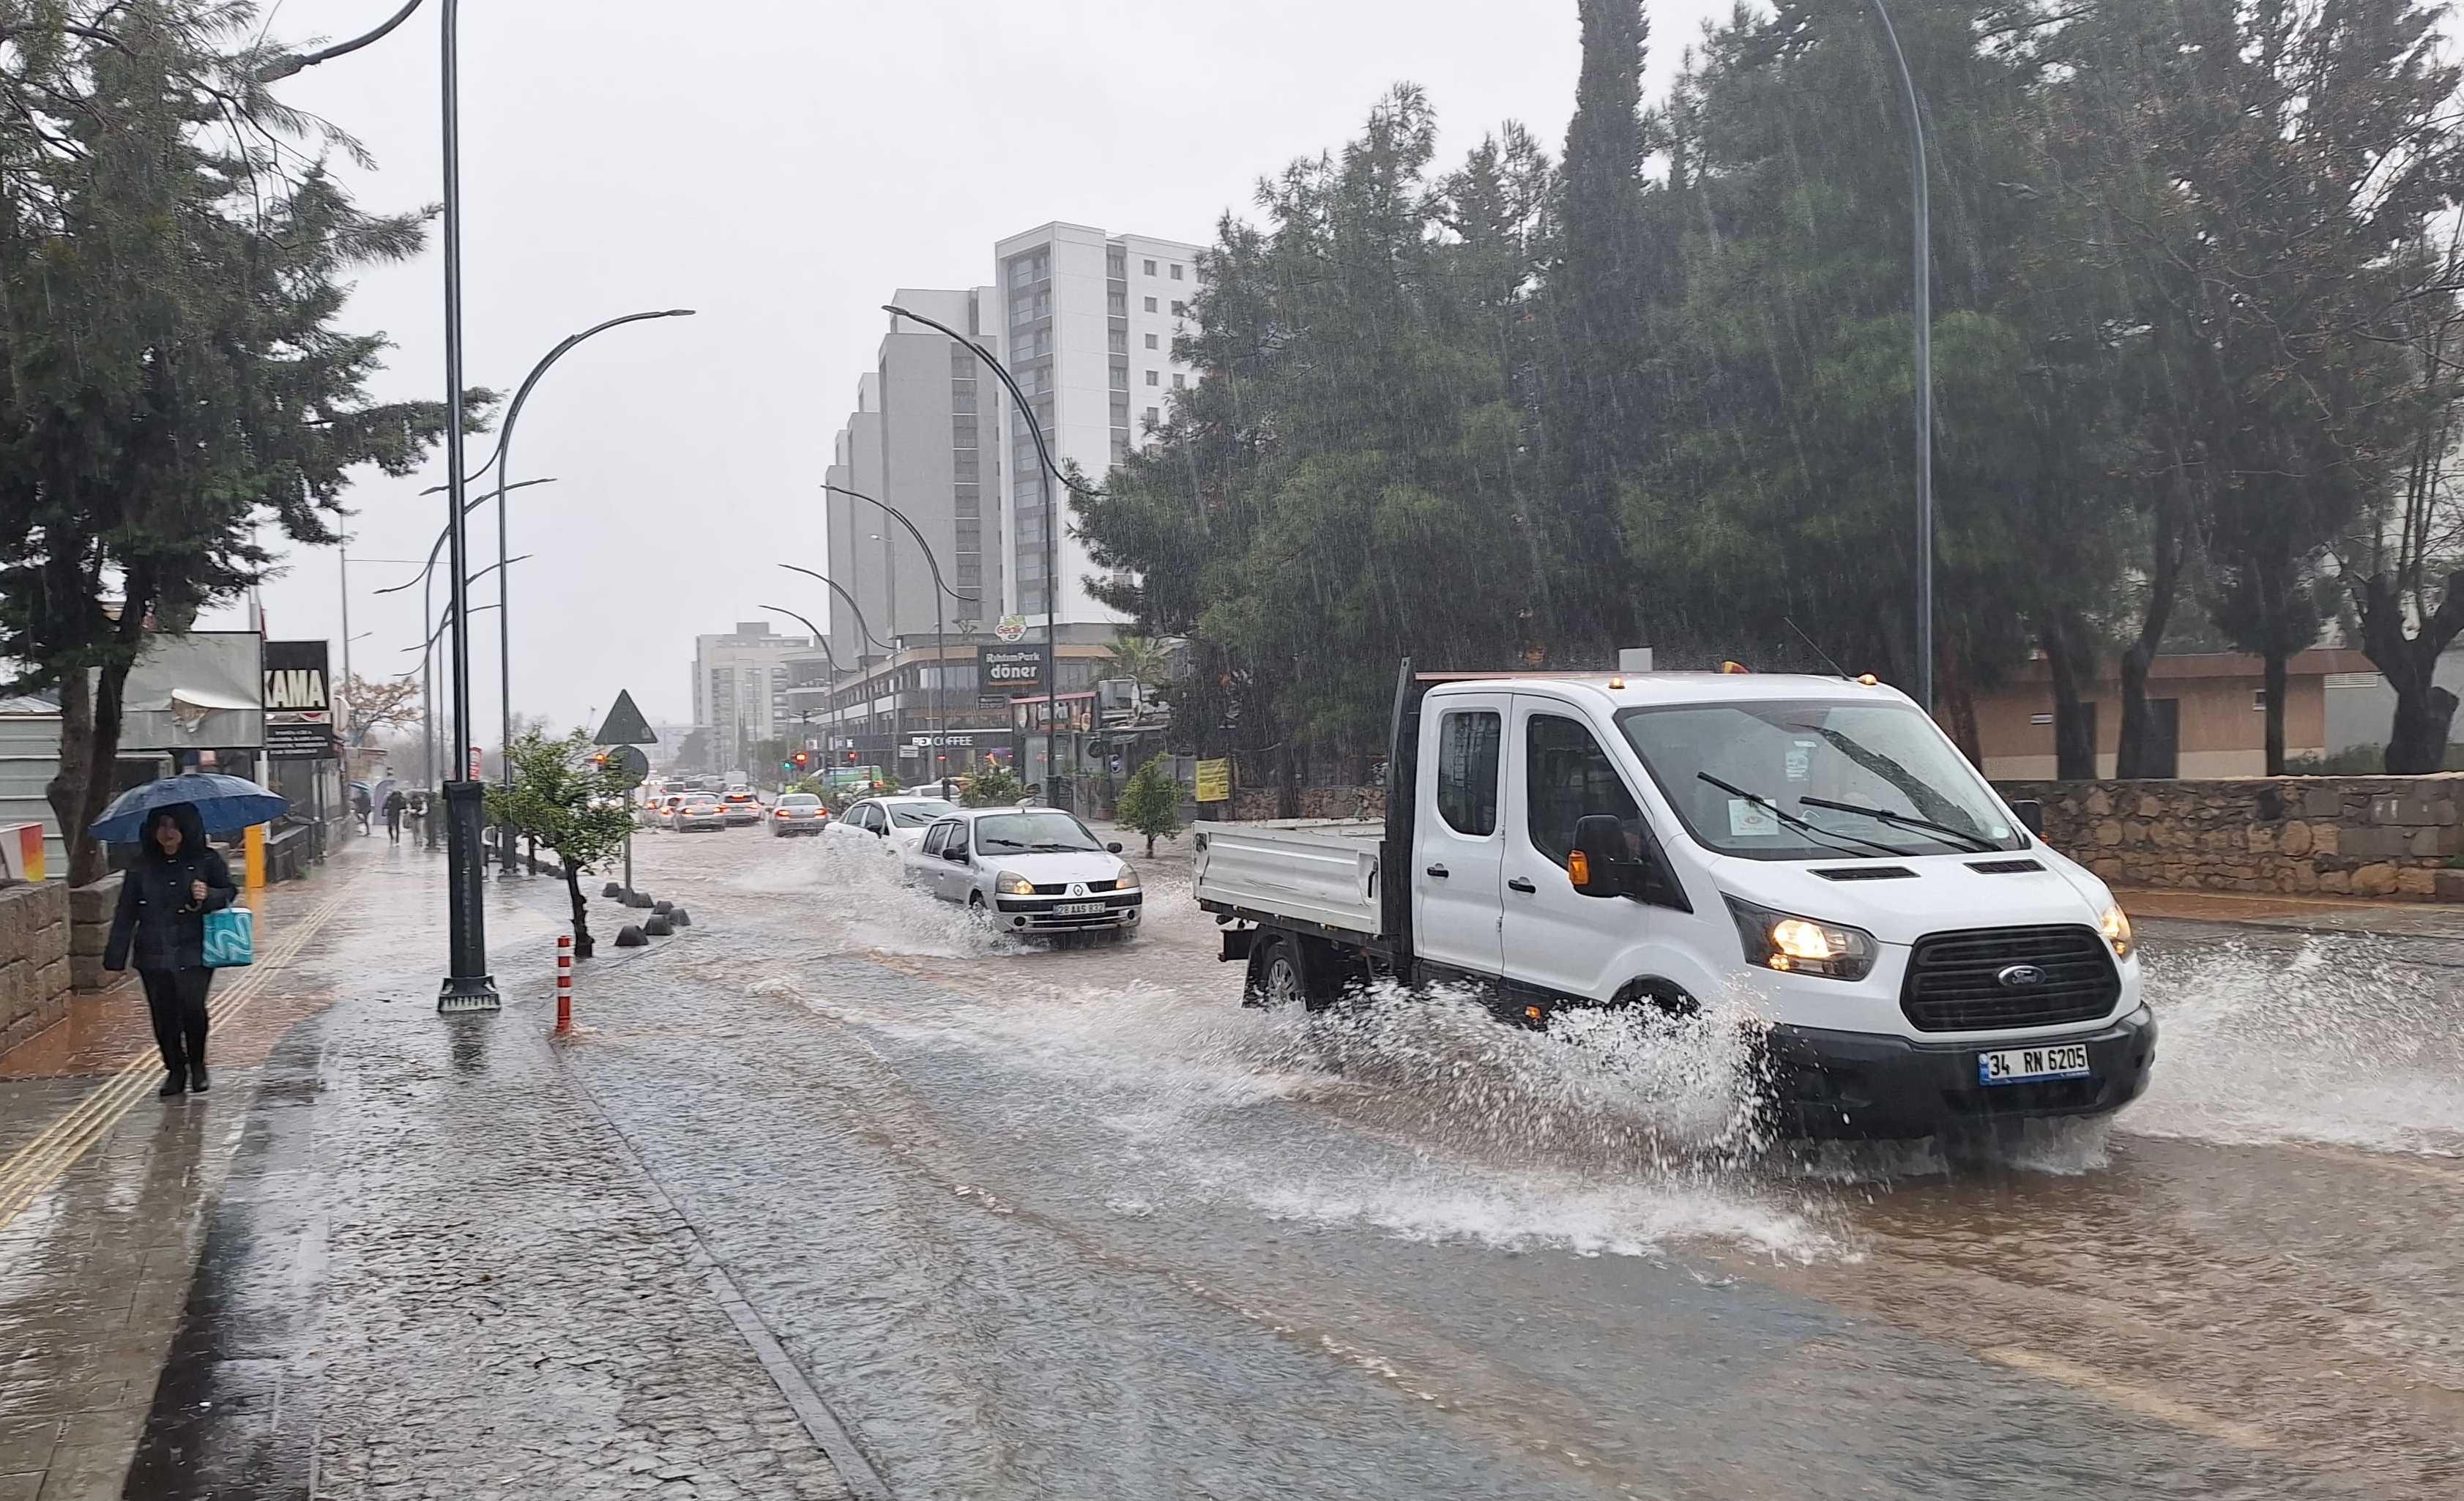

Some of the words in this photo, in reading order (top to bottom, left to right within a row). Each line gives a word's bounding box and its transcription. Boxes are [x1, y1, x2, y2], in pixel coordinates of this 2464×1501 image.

[990, 663, 1037, 679] döner
[933, 736, 974, 746] COFFEE
[1990, 1054, 2010, 1076] 34
[2024, 1051, 2044, 1073] RN
[2048, 1047, 2085, 1070] 6205
